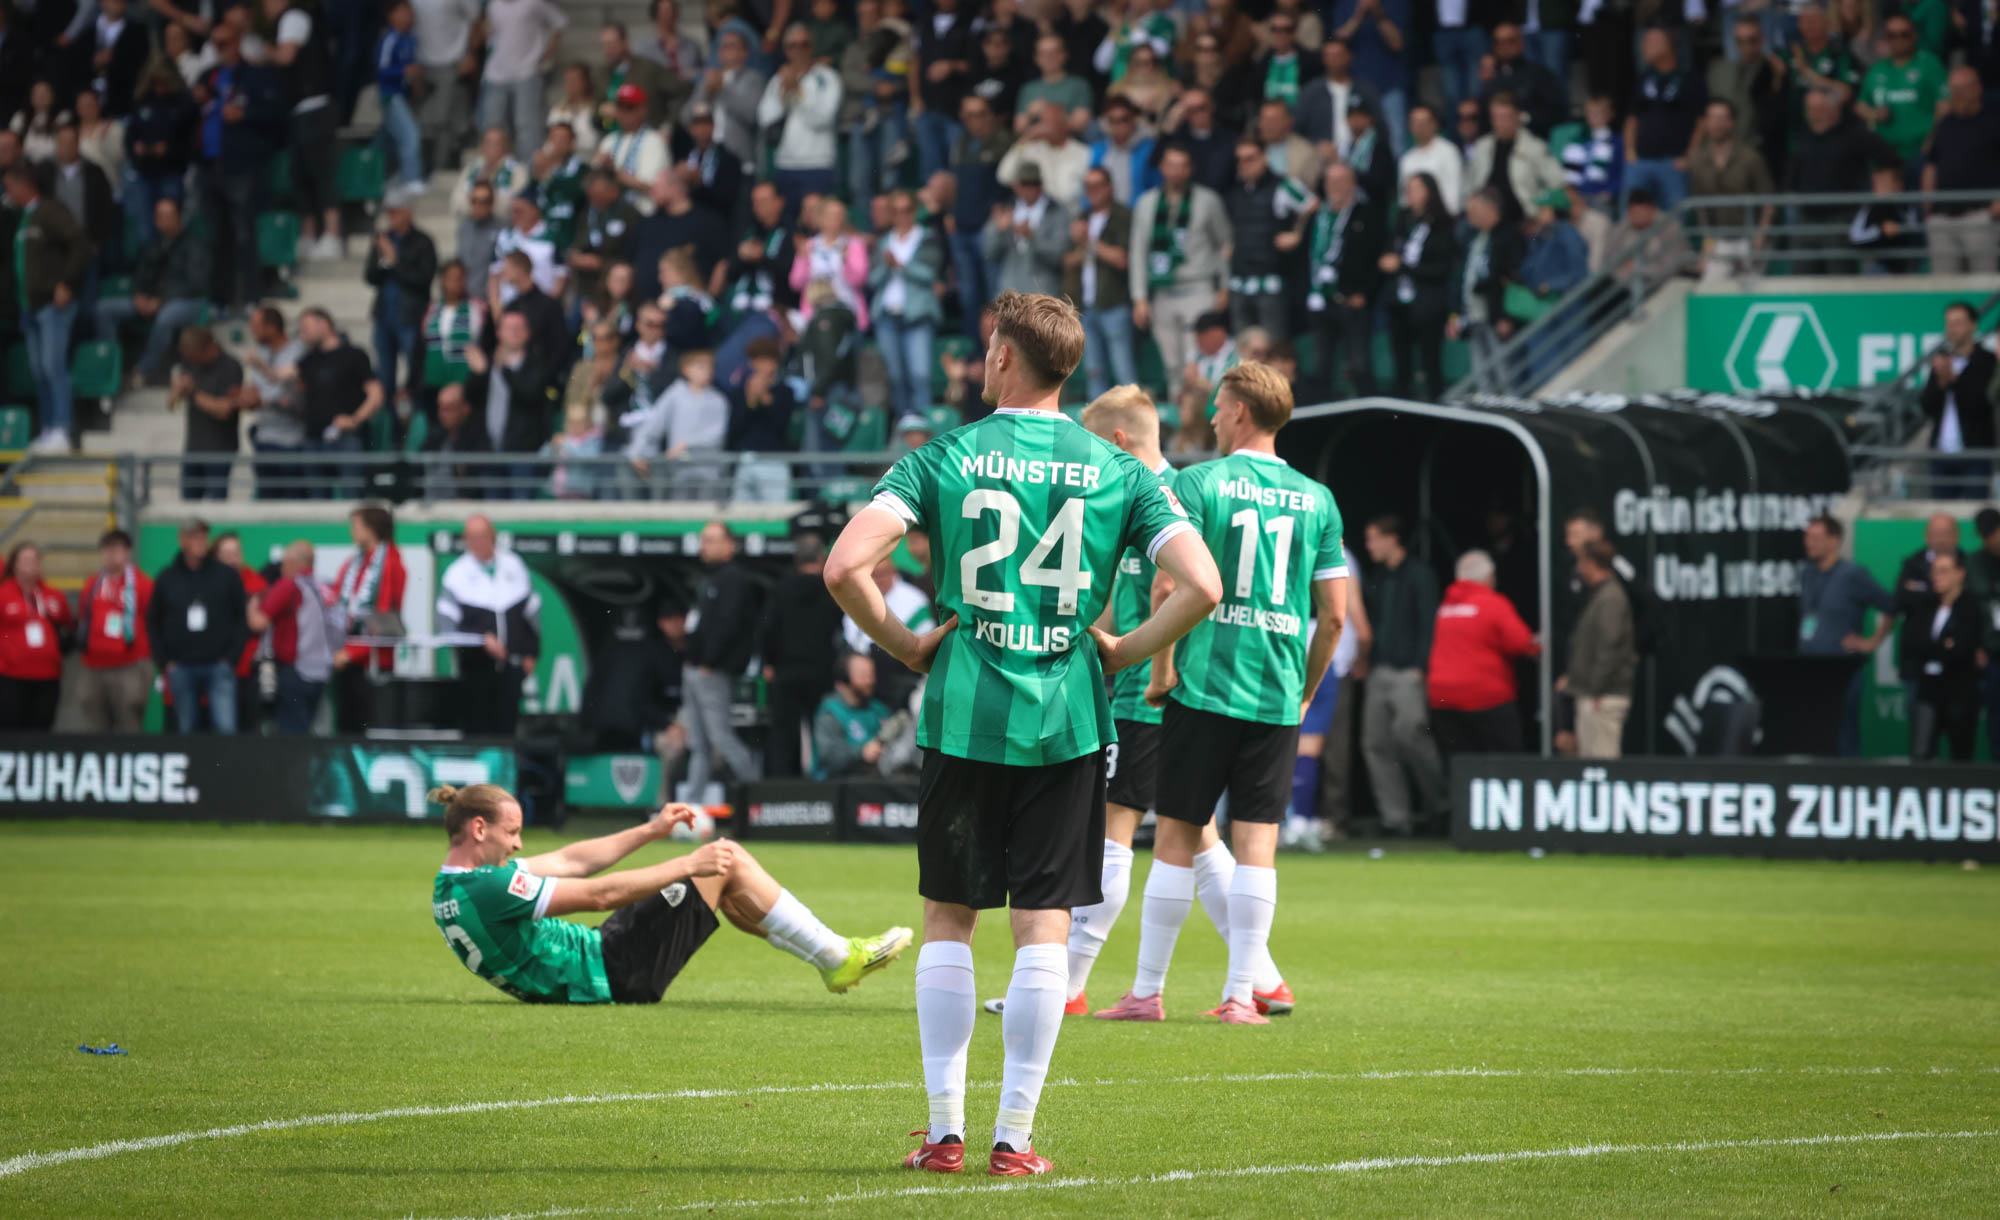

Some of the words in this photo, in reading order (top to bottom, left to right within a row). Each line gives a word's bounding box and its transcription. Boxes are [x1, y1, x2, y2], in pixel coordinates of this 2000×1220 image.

[960, 451, 1100, 489] MÜNSTER
[1217, 477, 1315, 513] MÜNSTER
[1614, 484, 1690, 535] Grün
[1694, 487, 1737, 533] ist
[960, 488, 1091, 616] 24
[1231, 508, 1295, 606] 11
[1654, 552, 1719, 600] Und
[974, 616, 1070, 652] KOULIS
[0, 753, 199, 803] ZUHAUSE.
[1470, 778, 1522, 831] IN
[1534, 767, 1774, 837] MÜNSTER
[1787, 785, 2000, 841] ZUHAUS
